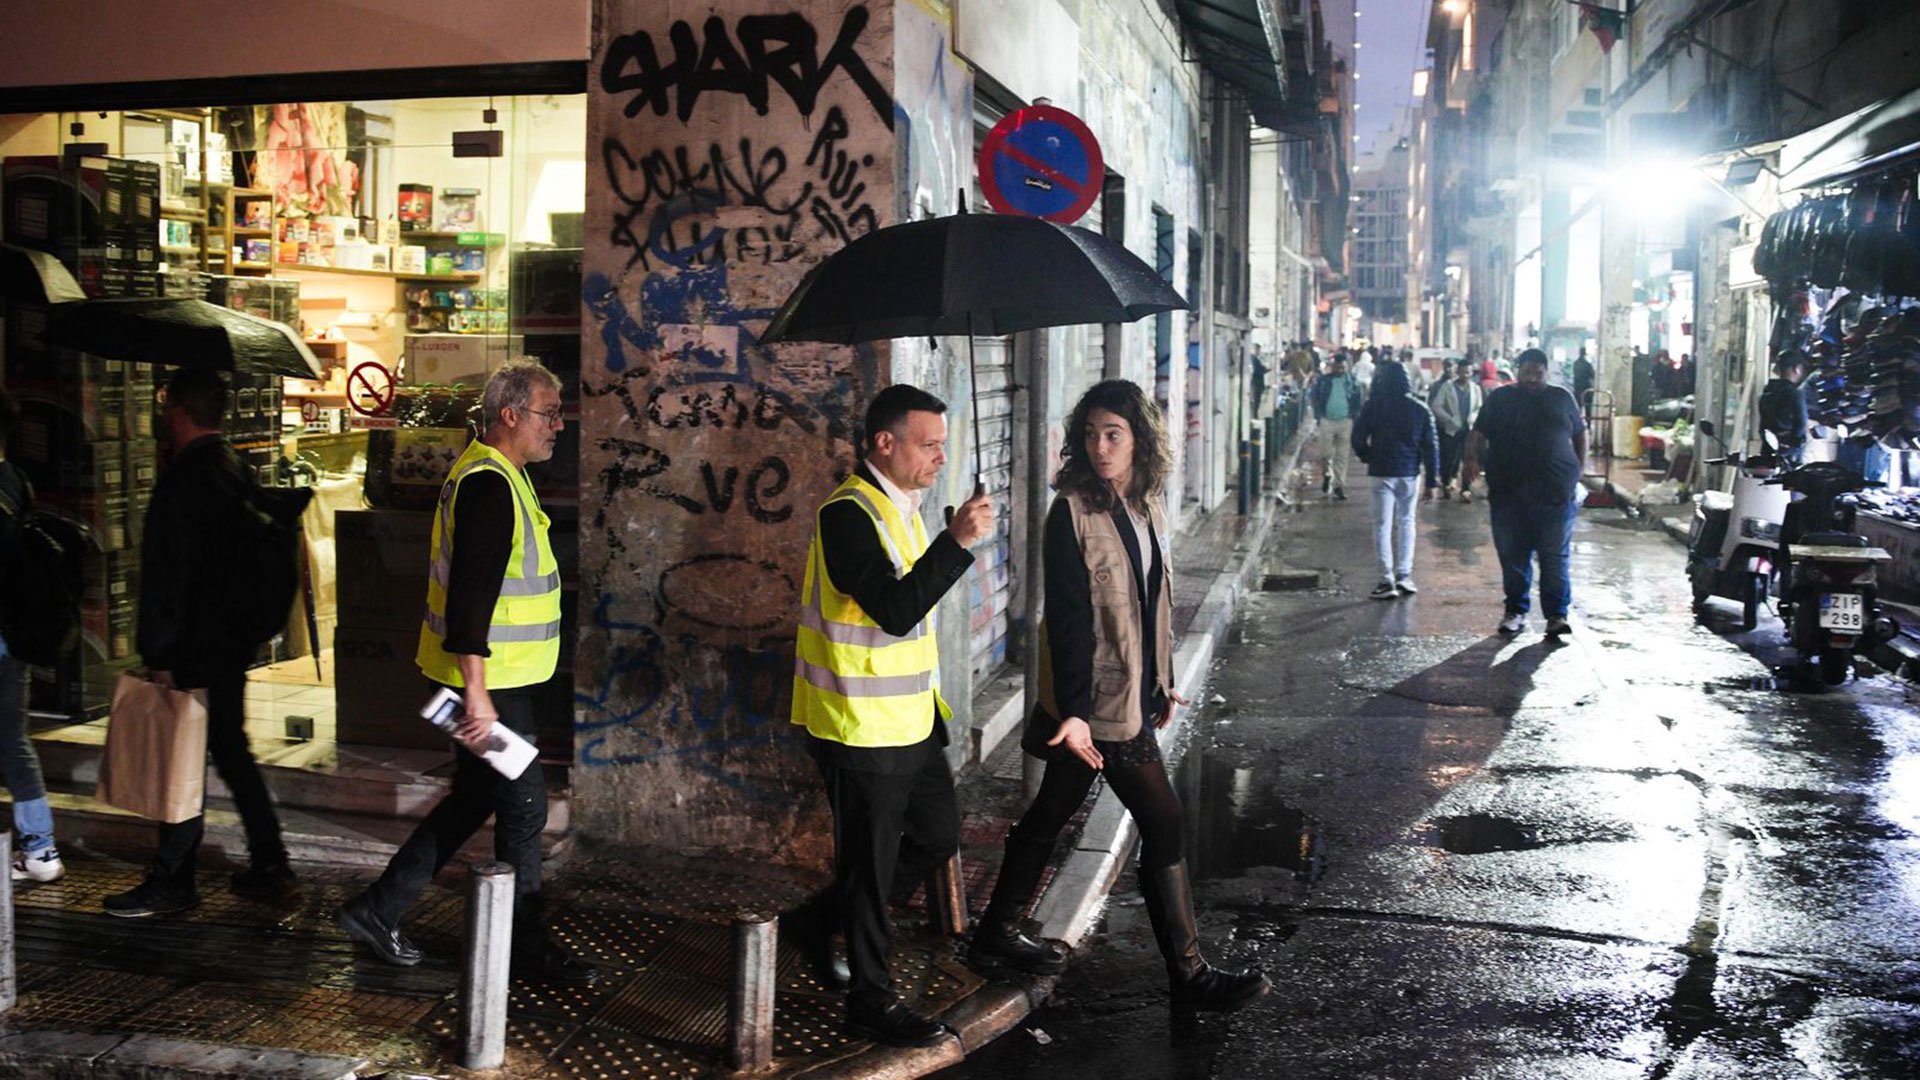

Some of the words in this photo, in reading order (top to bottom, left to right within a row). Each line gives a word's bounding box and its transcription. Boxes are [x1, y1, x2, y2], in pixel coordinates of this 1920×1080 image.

[601, 5, 895, 131] SHARK
[1831, 596, 1859, 609] ZIP
[1831, 612, 1860, 626] 298
